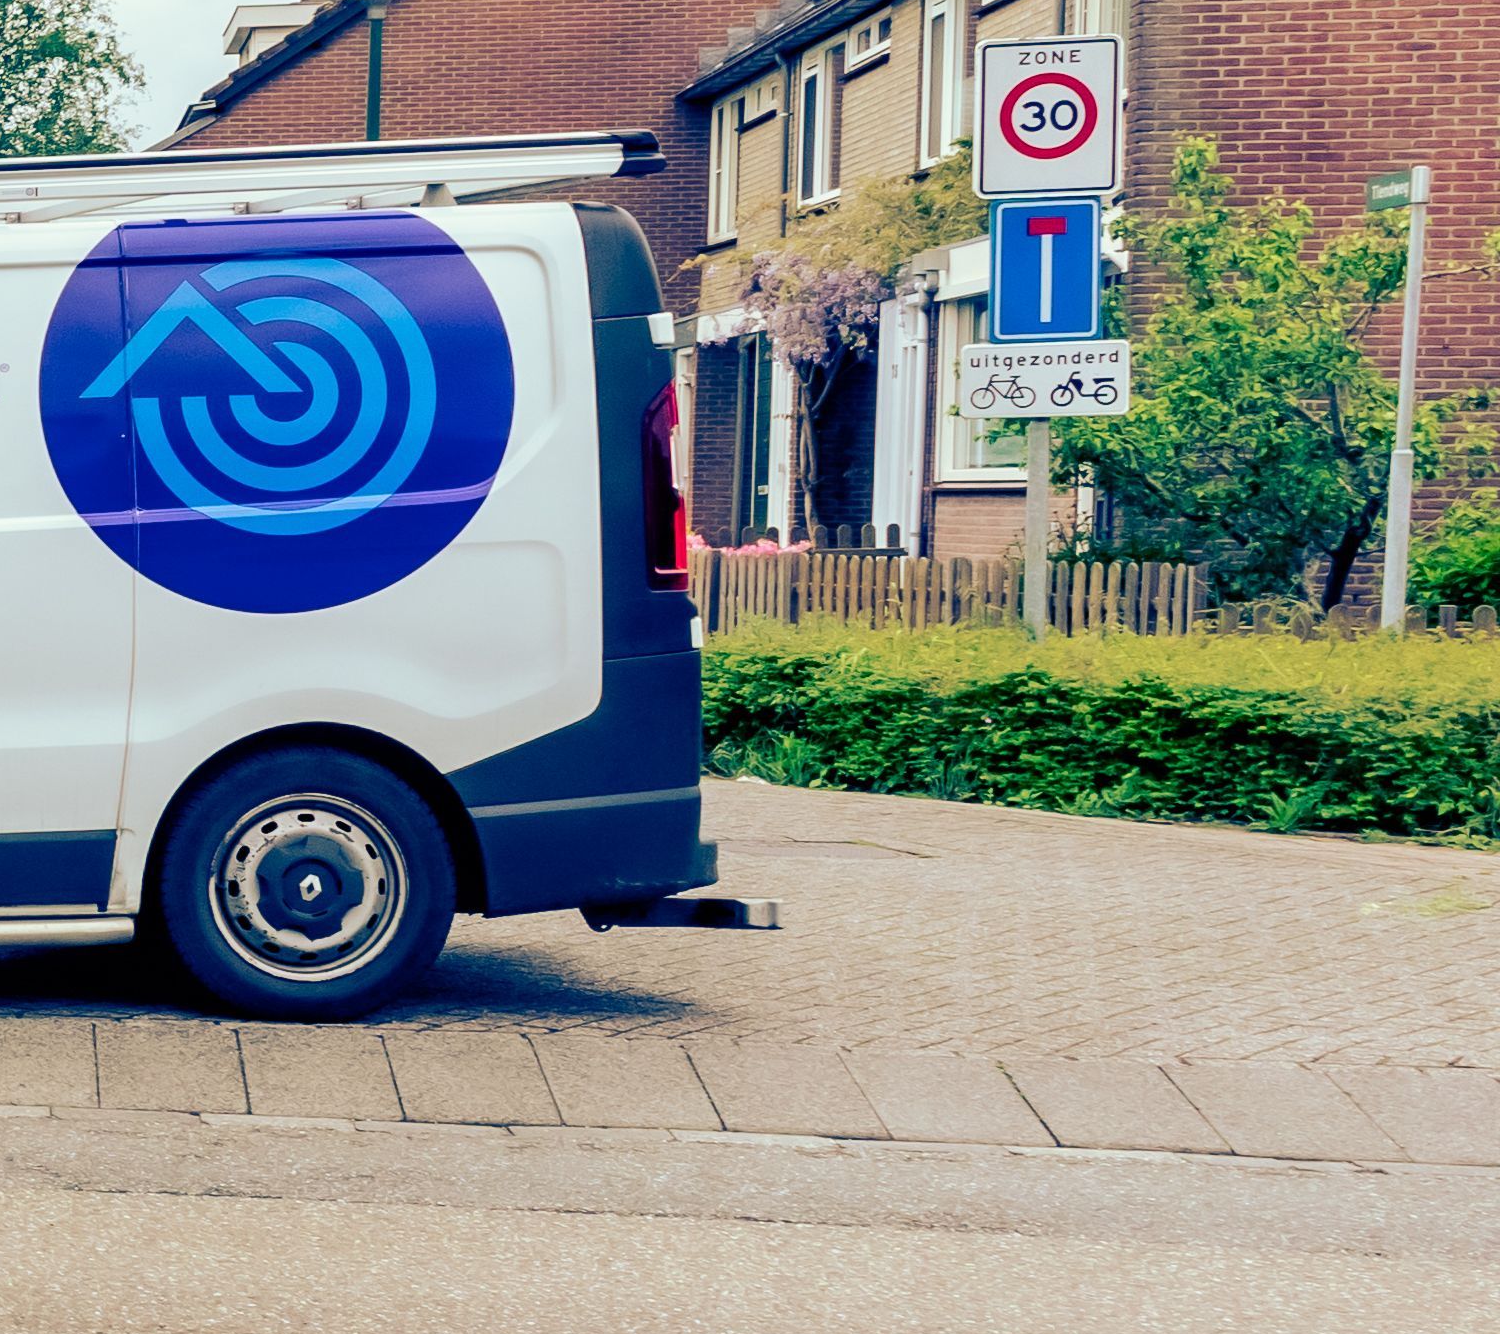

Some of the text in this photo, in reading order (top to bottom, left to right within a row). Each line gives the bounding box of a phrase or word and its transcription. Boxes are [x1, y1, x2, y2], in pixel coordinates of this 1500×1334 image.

[1019, 50, 1081, 65] ZONE
[1019, 100, 1078, 132] 30
[970, 350, 1119, 370] uitgezonderd
